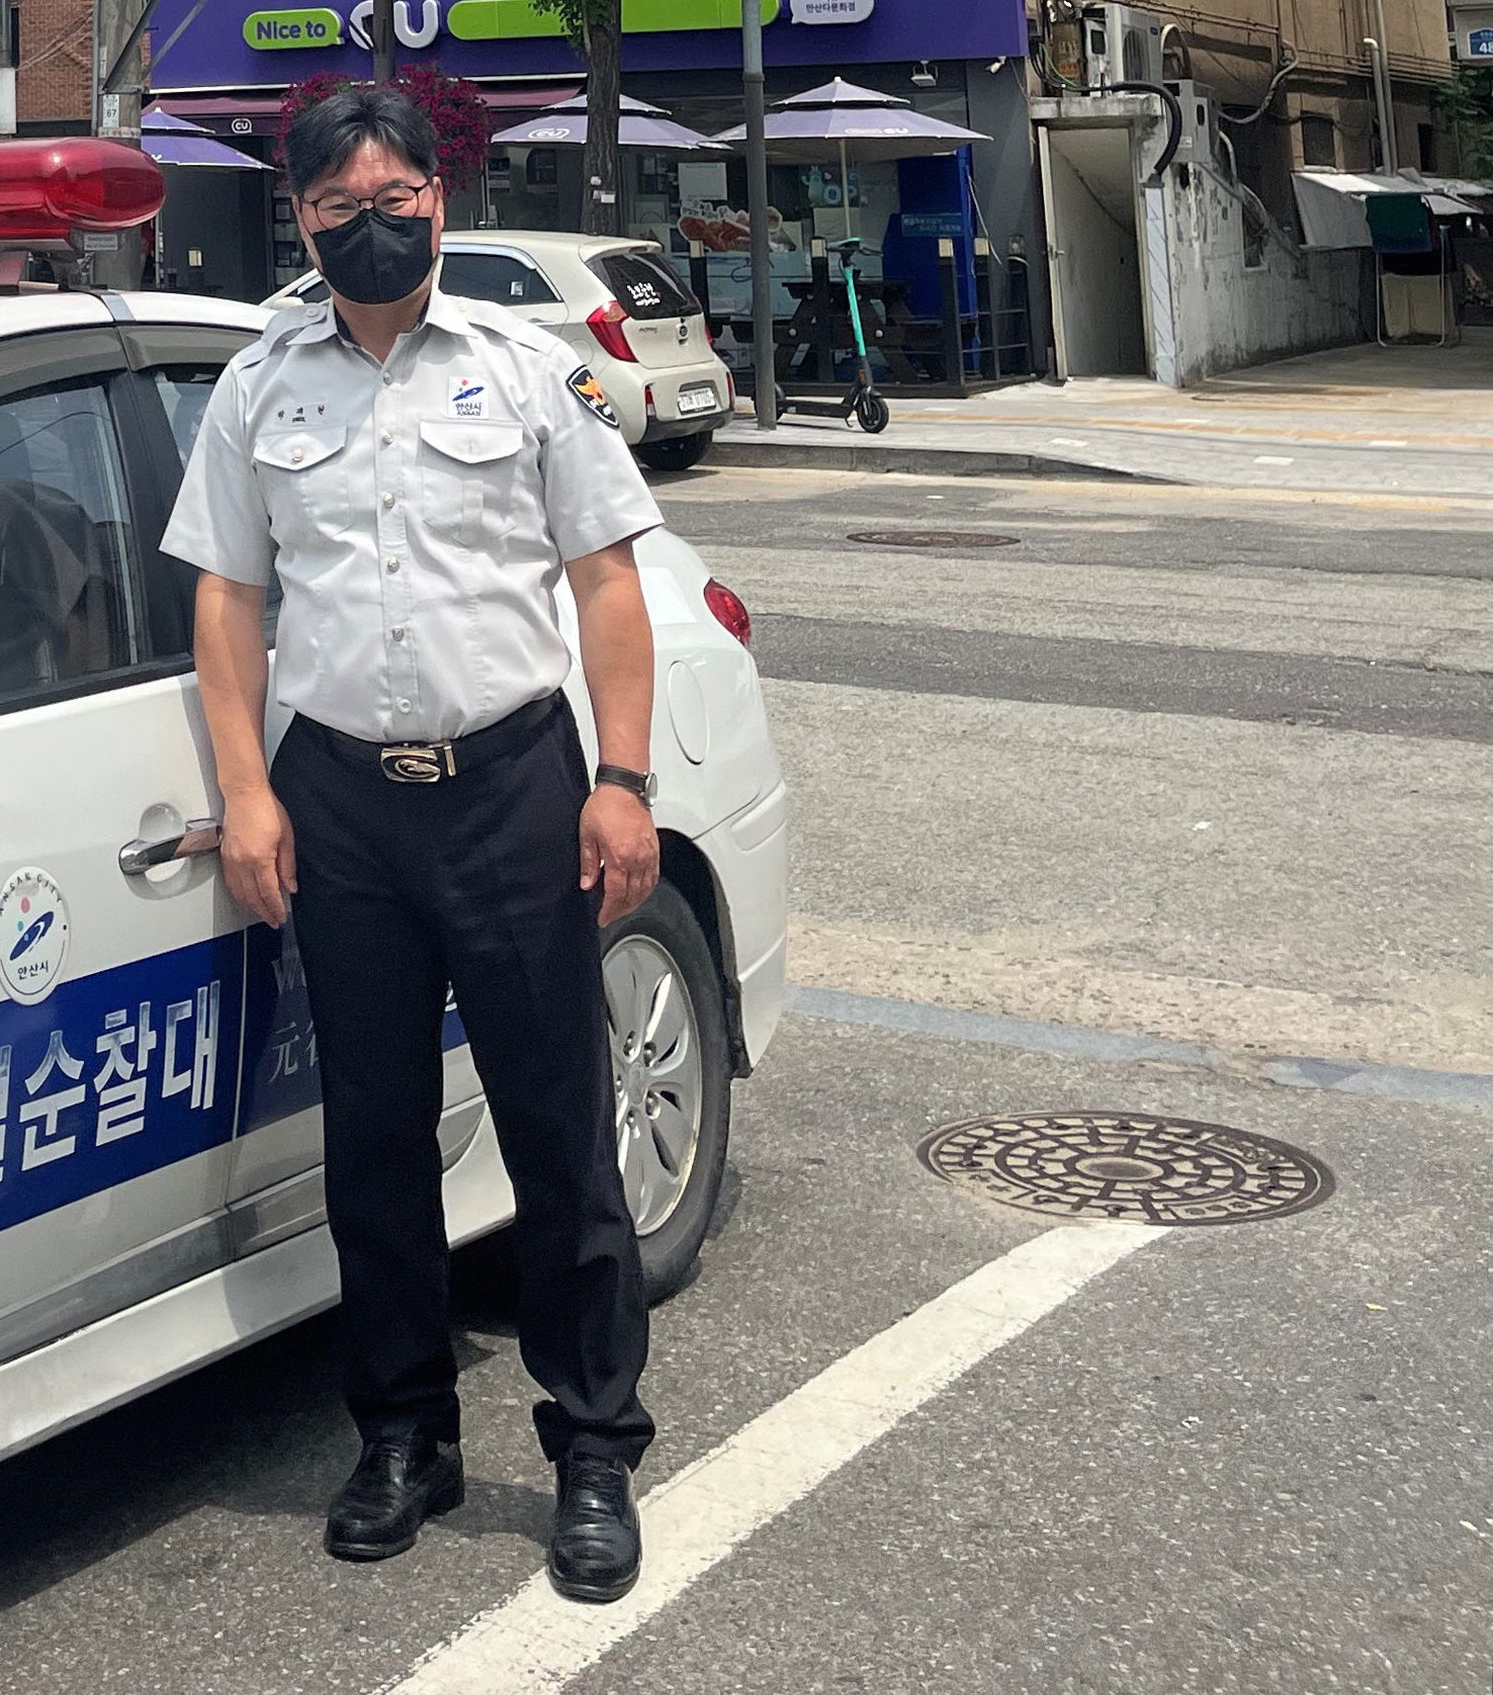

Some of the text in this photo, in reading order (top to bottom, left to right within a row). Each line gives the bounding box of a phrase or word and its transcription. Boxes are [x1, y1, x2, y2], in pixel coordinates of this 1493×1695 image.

[256, 20, 301, 41] Nice
[305, 20, 327, 39] to
[17, 959, 49, 980] 안산시
